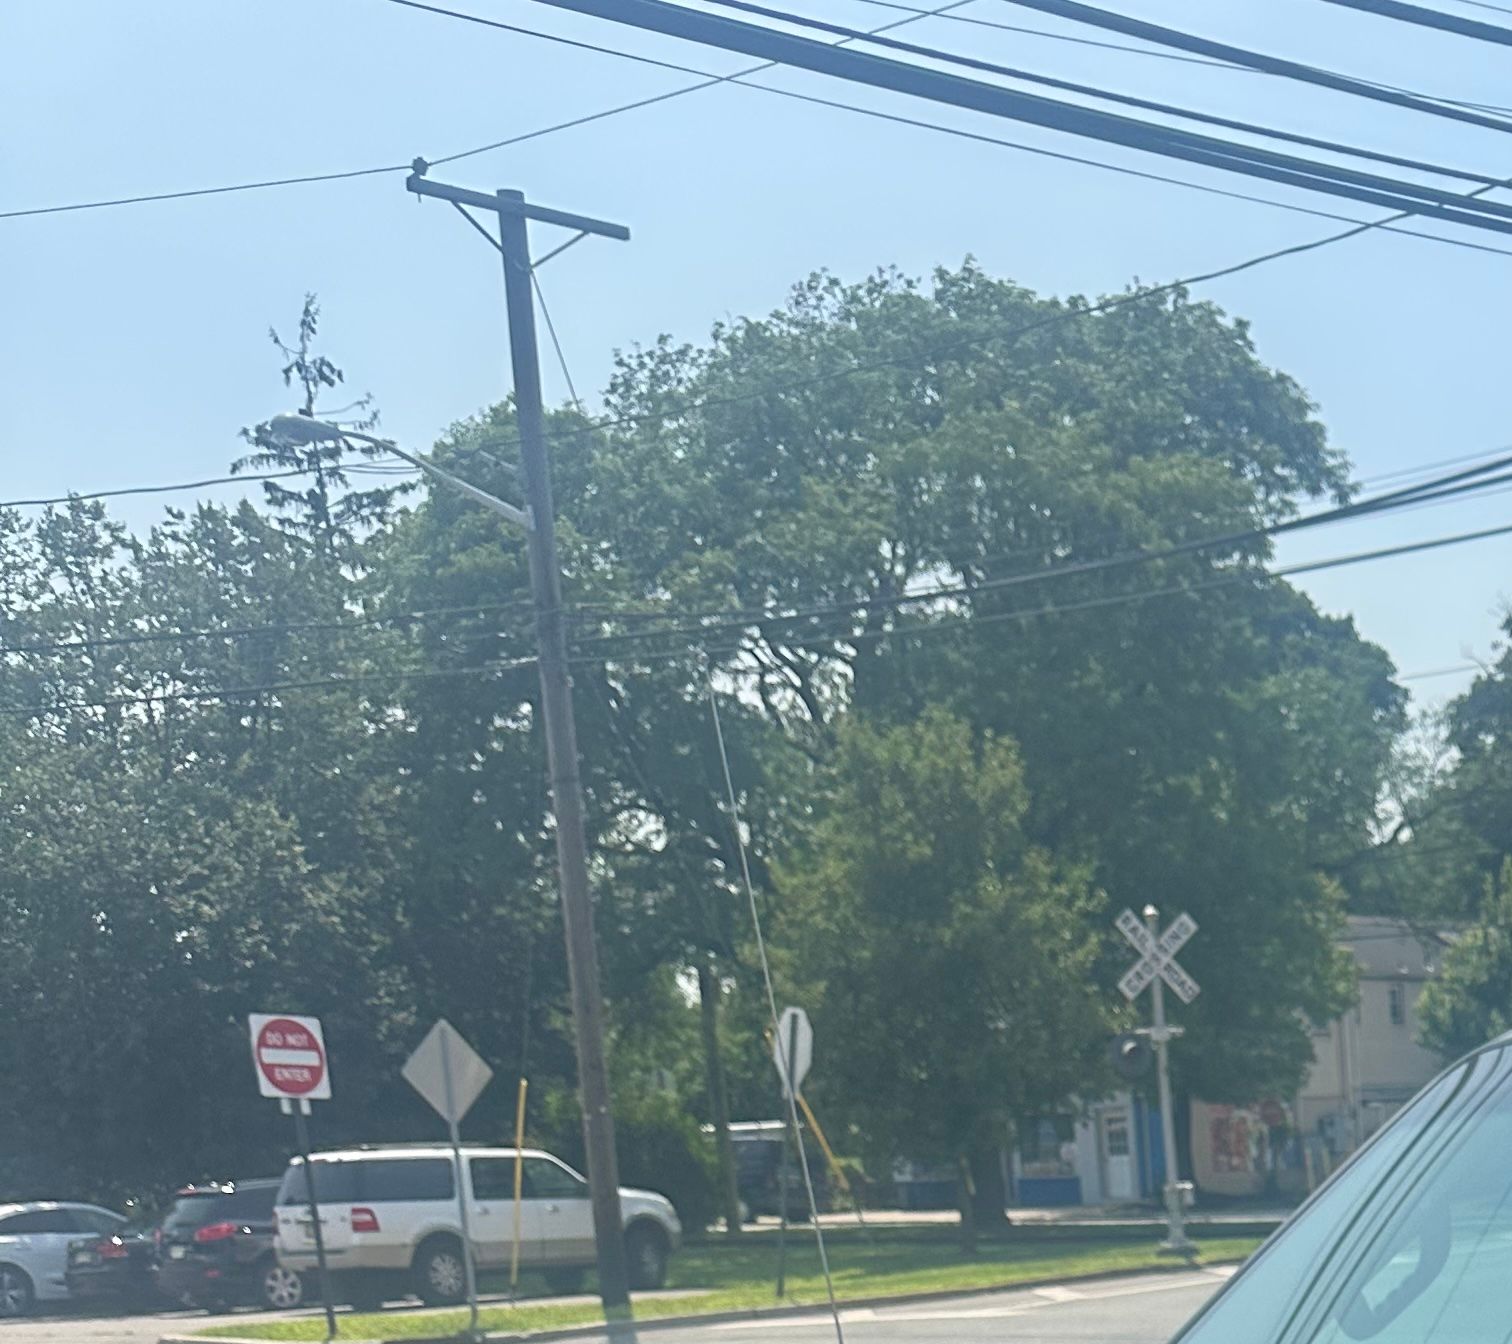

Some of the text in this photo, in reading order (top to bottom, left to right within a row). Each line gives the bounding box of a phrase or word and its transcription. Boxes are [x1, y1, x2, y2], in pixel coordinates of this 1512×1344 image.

[1124, 920, 1193, 994] CROSSING
[265, 1030, 309, 1047] DO NOT
[274, 1067, 313, 1082] ENTER
